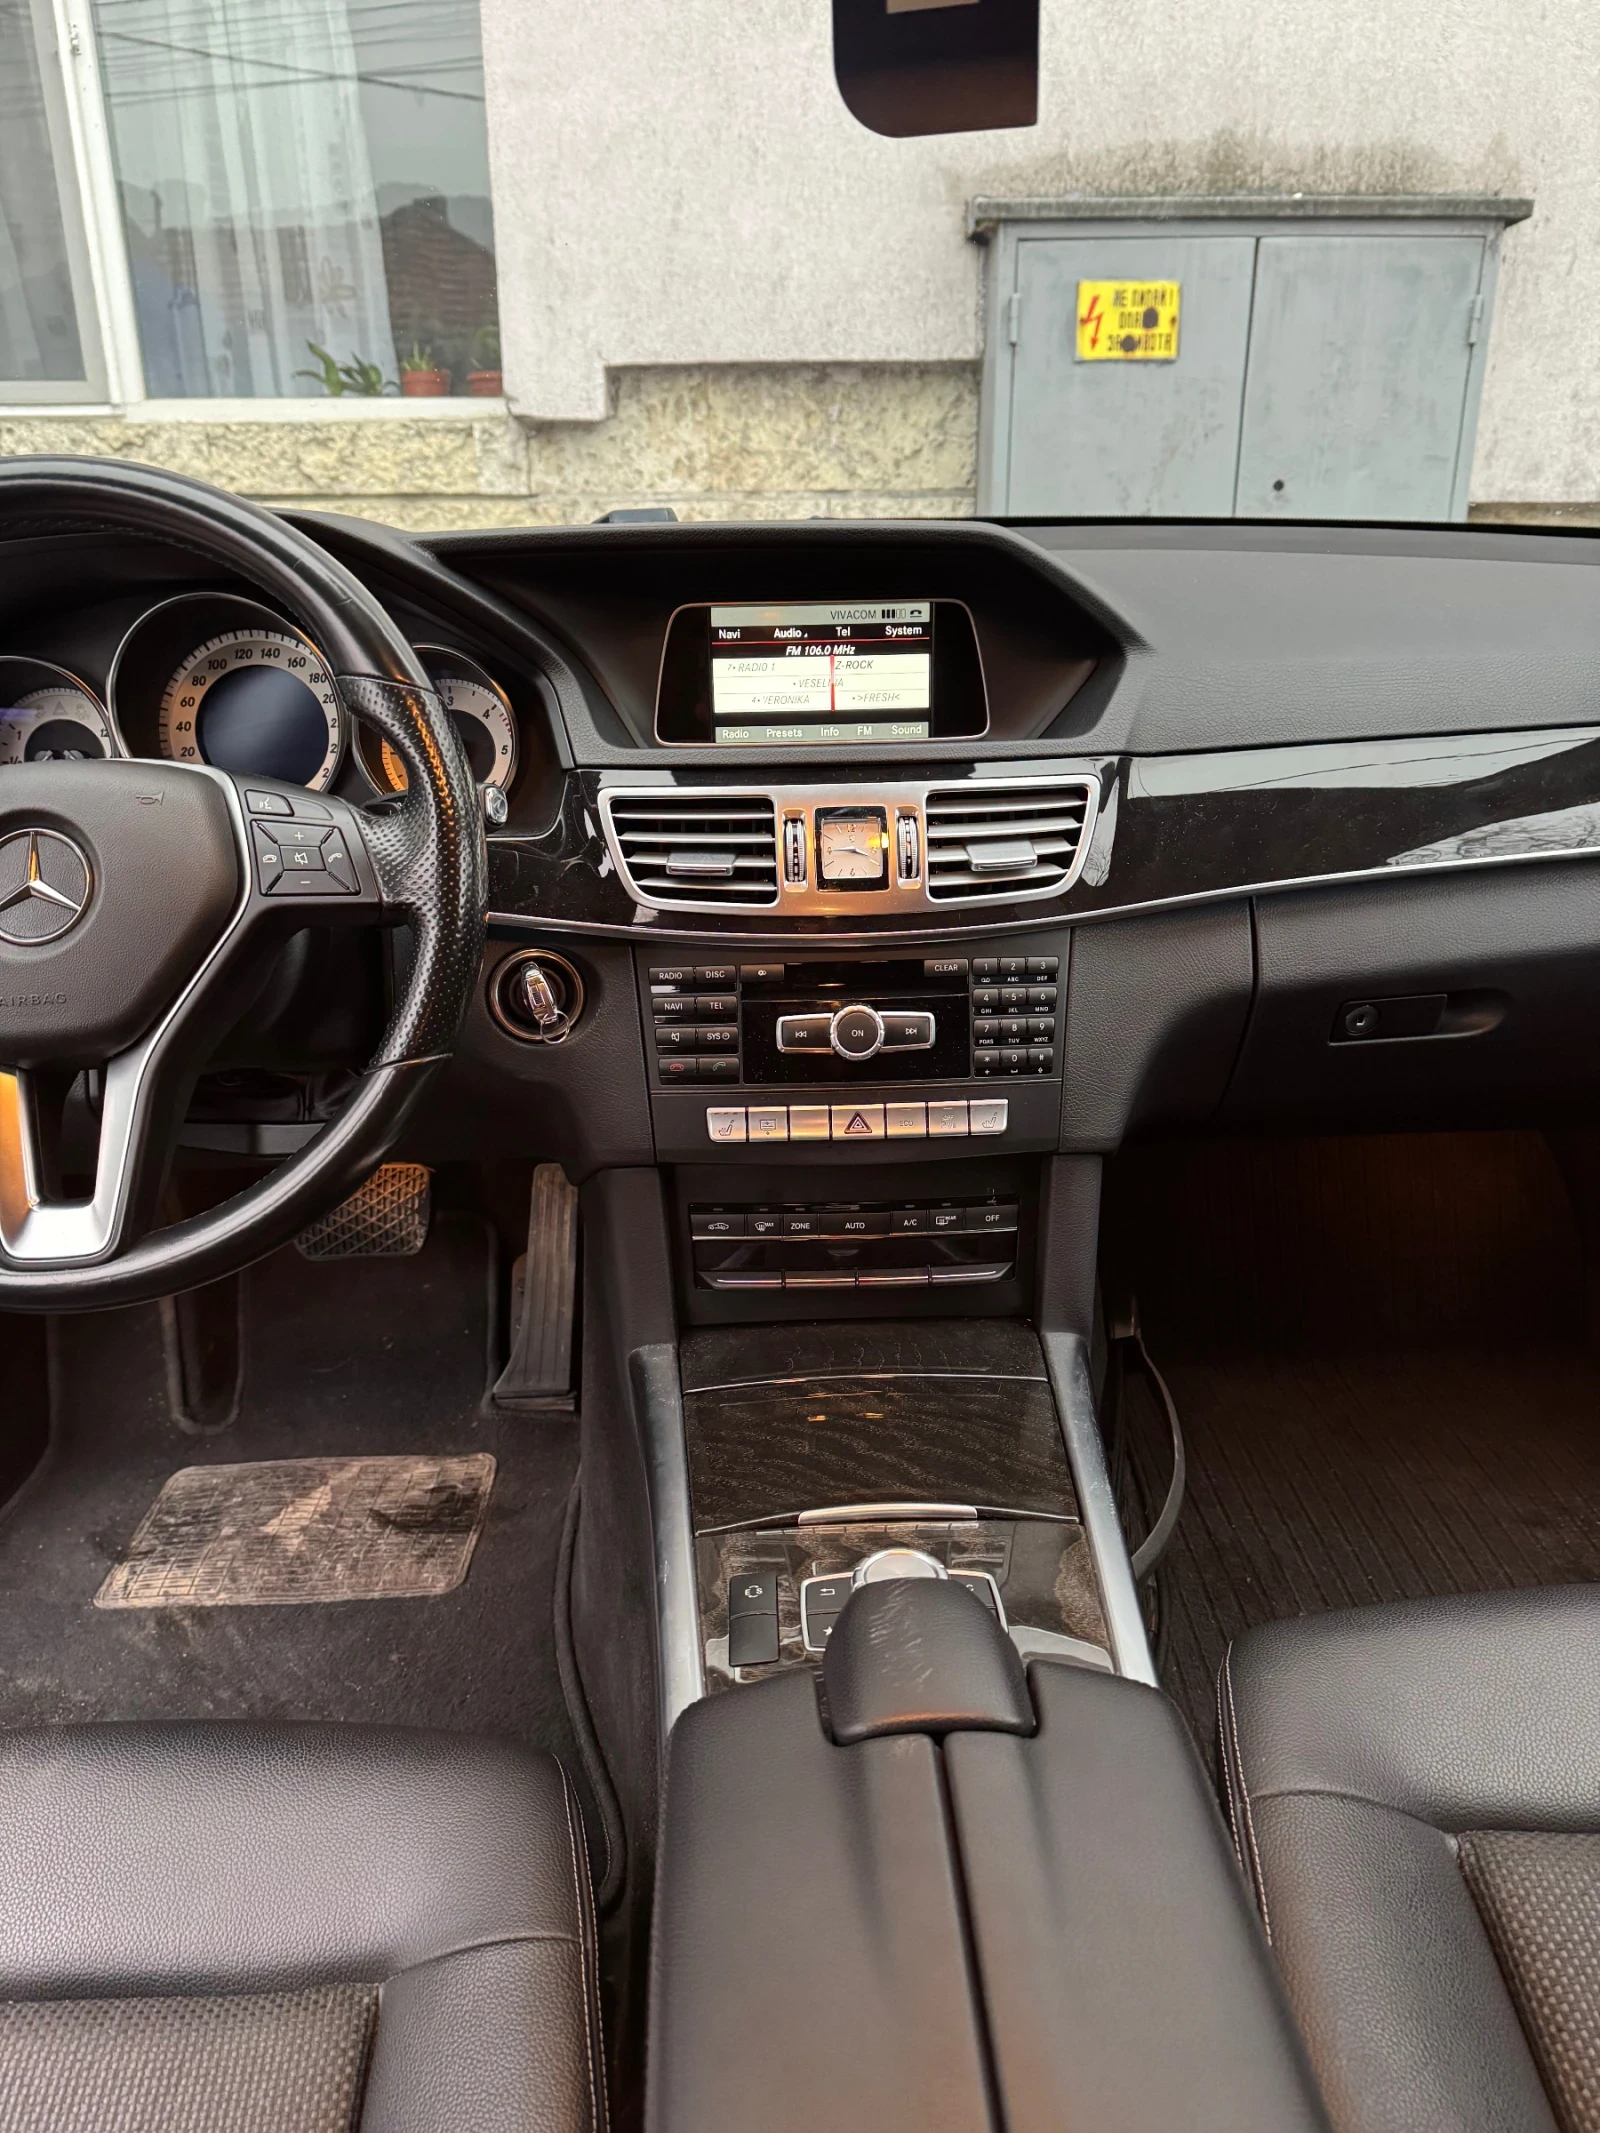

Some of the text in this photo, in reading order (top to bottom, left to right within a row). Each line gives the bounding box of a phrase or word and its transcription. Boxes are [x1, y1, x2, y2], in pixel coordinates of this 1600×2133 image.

[830, 609, 877, 620] VIVACOM
[718, 629, 741, 639] Navi
[773, 627, 802, 638] Audio
[835, 627, 851, 637] Tel
[885, 625, 923, 637] System
[233, 648, 253, 660] 120
[260, 647, 281, 659] 140
[785, 645, 856, 656] FM 106.0 MHz
[207, 658, 228, 671] 100
[287, 657, 307, 669] 160
[738, 662, 768, 672] RADIO
[834, 659, 874, 670] Z-ROCK
[191, 675, 207, 687] 80
[308, 672, 327, 684] 180
[180, 696, 195, 708] 60
[762, 694, 810, 705] VERONIKA
[482, 709, 490, 719] 4
[175, 720, 192, 732] 40
[857, 726, 873, 736] FM
[891, 724, 923, 735] Sound
[722, 729, 749, 739] Radio
[766, 727, 803, 738] Presets
[820, 726, 840, 737] Info
[180, 746, 196, 757] 20
[501, 745, 508, 754] 5
[934, 964, 959, 972] CLEAR
[1010, 962, 1016, 971] 2
[1040, 961, 1046, 970] 3
[658, 972, 683, 980] RADIO
[705, 970, 726, 979] DISC
[983, 993, 989, 1002] 4
[1040, 992, 1046, 1001] 6
[664, 1002, 683, 1011] NAVI
[709, 1002, 724, 1010] TEL
[984, 1024, 989, 1033] 7
[1011, 1023, 1018, 1032] 8
[1039, 1022, 1045, 1031] 9
[706, 1032, 721, 1041] SYS
[851, 1029, 864, 1037] ON
[1011, 1054, 1018, 1062] 0
[903, 1218, 918, 1227] A/C
[985, 1214, 1000, 1222] OFF
[790, 1222, 811, 1230] ZONE
[844, 1221, 866, 1230] AUTO
